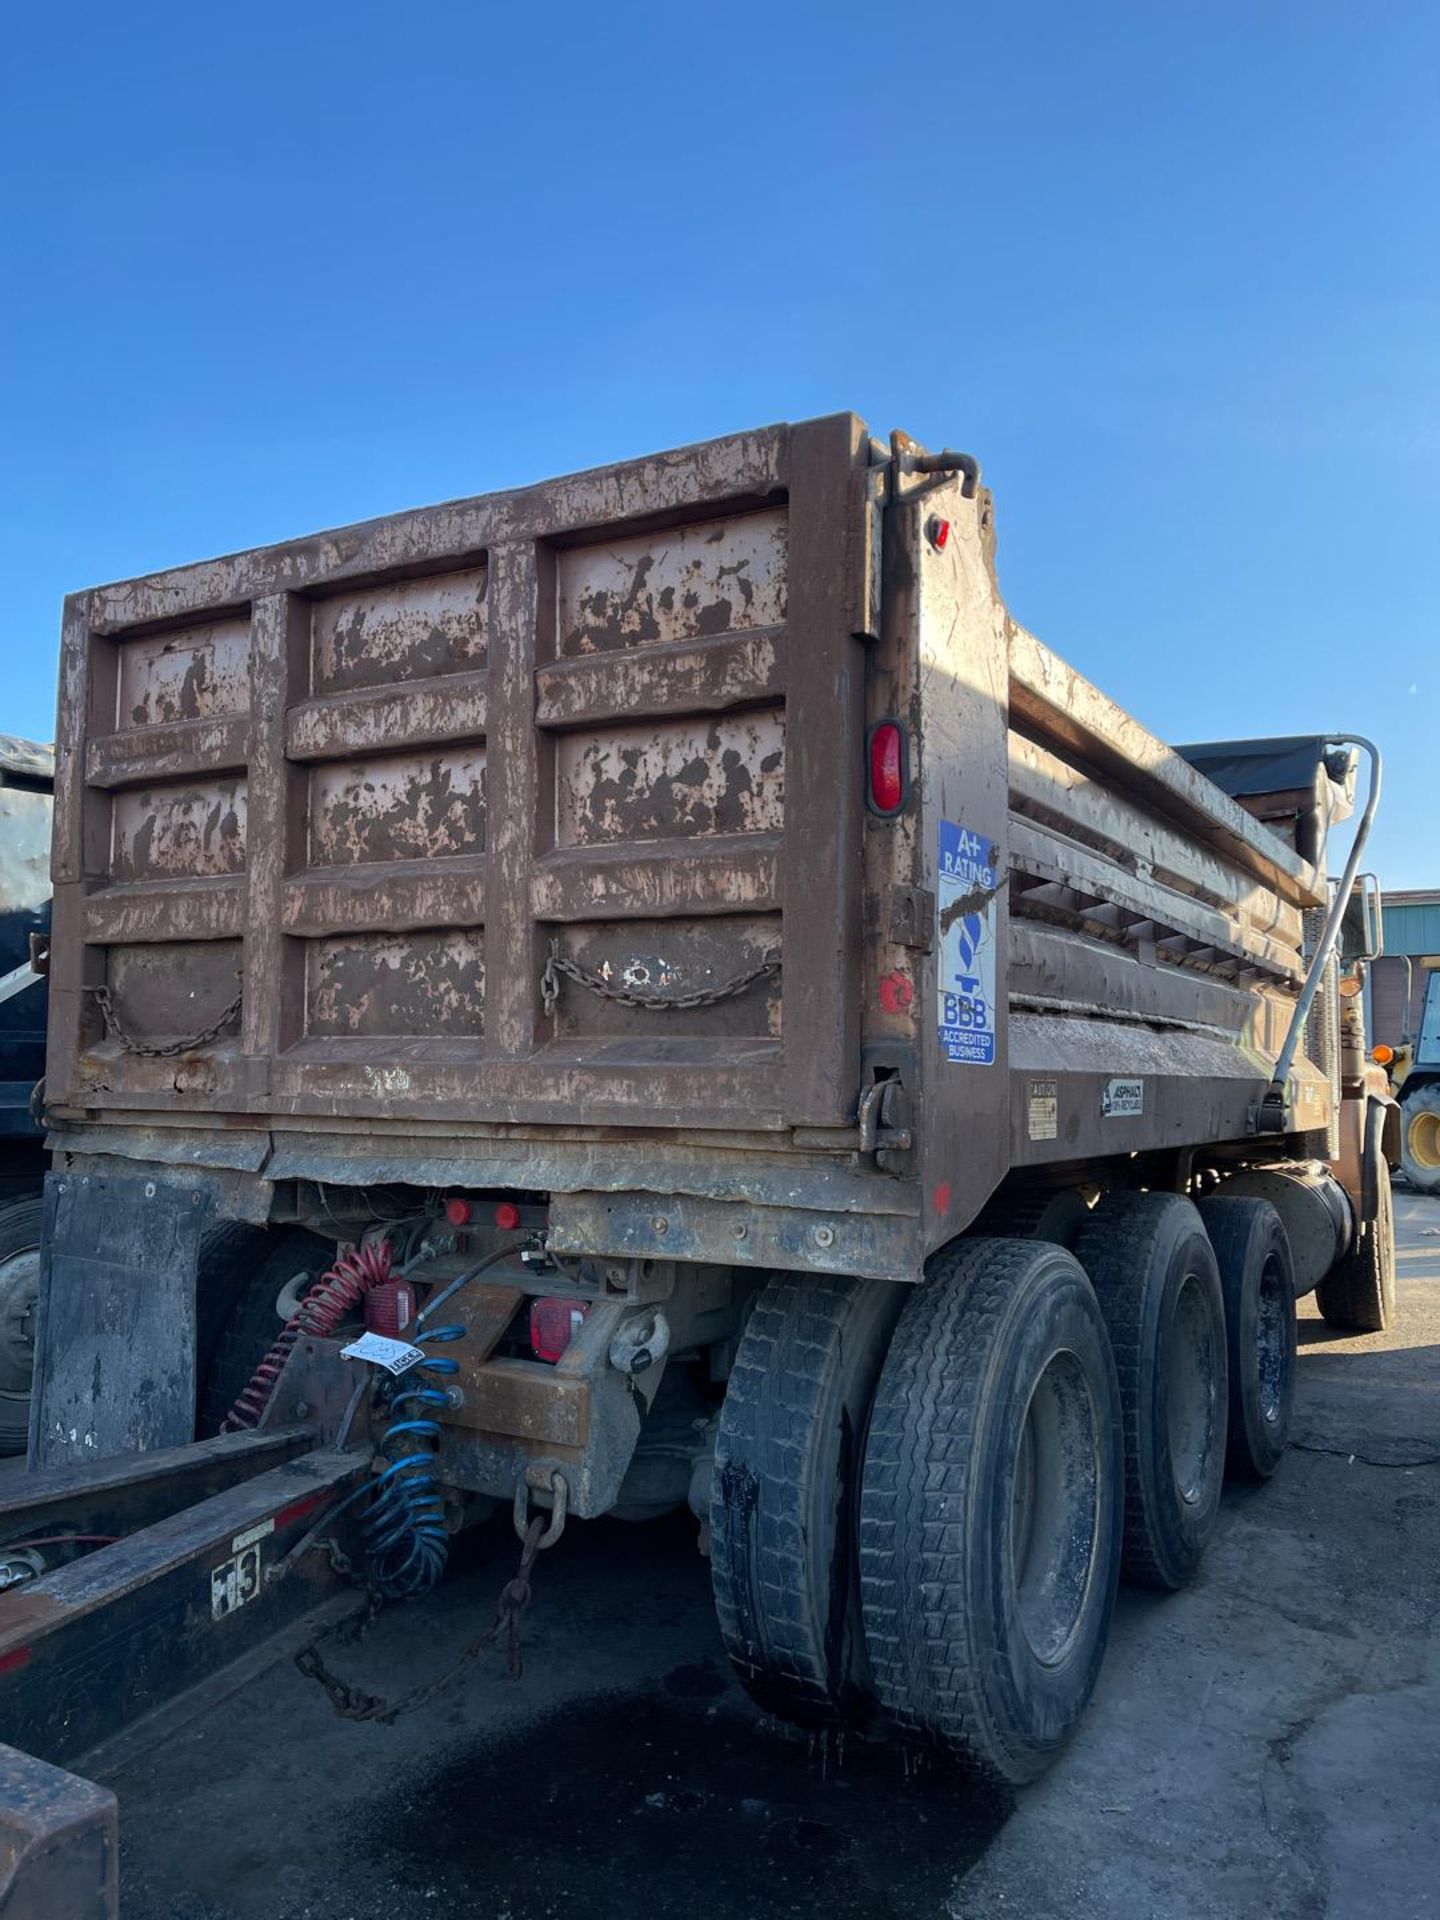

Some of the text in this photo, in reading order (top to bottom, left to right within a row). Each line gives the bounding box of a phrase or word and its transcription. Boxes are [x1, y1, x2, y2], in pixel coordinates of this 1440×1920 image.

[957, 829, 981, 858] A+
[944, 857, 992, 886] RATING
[944, 993, 986, 1029] BBB
[943, 1030, 991, 1047] ACCREDITED
[949, 1045, 986, 1059] BUSINESS
